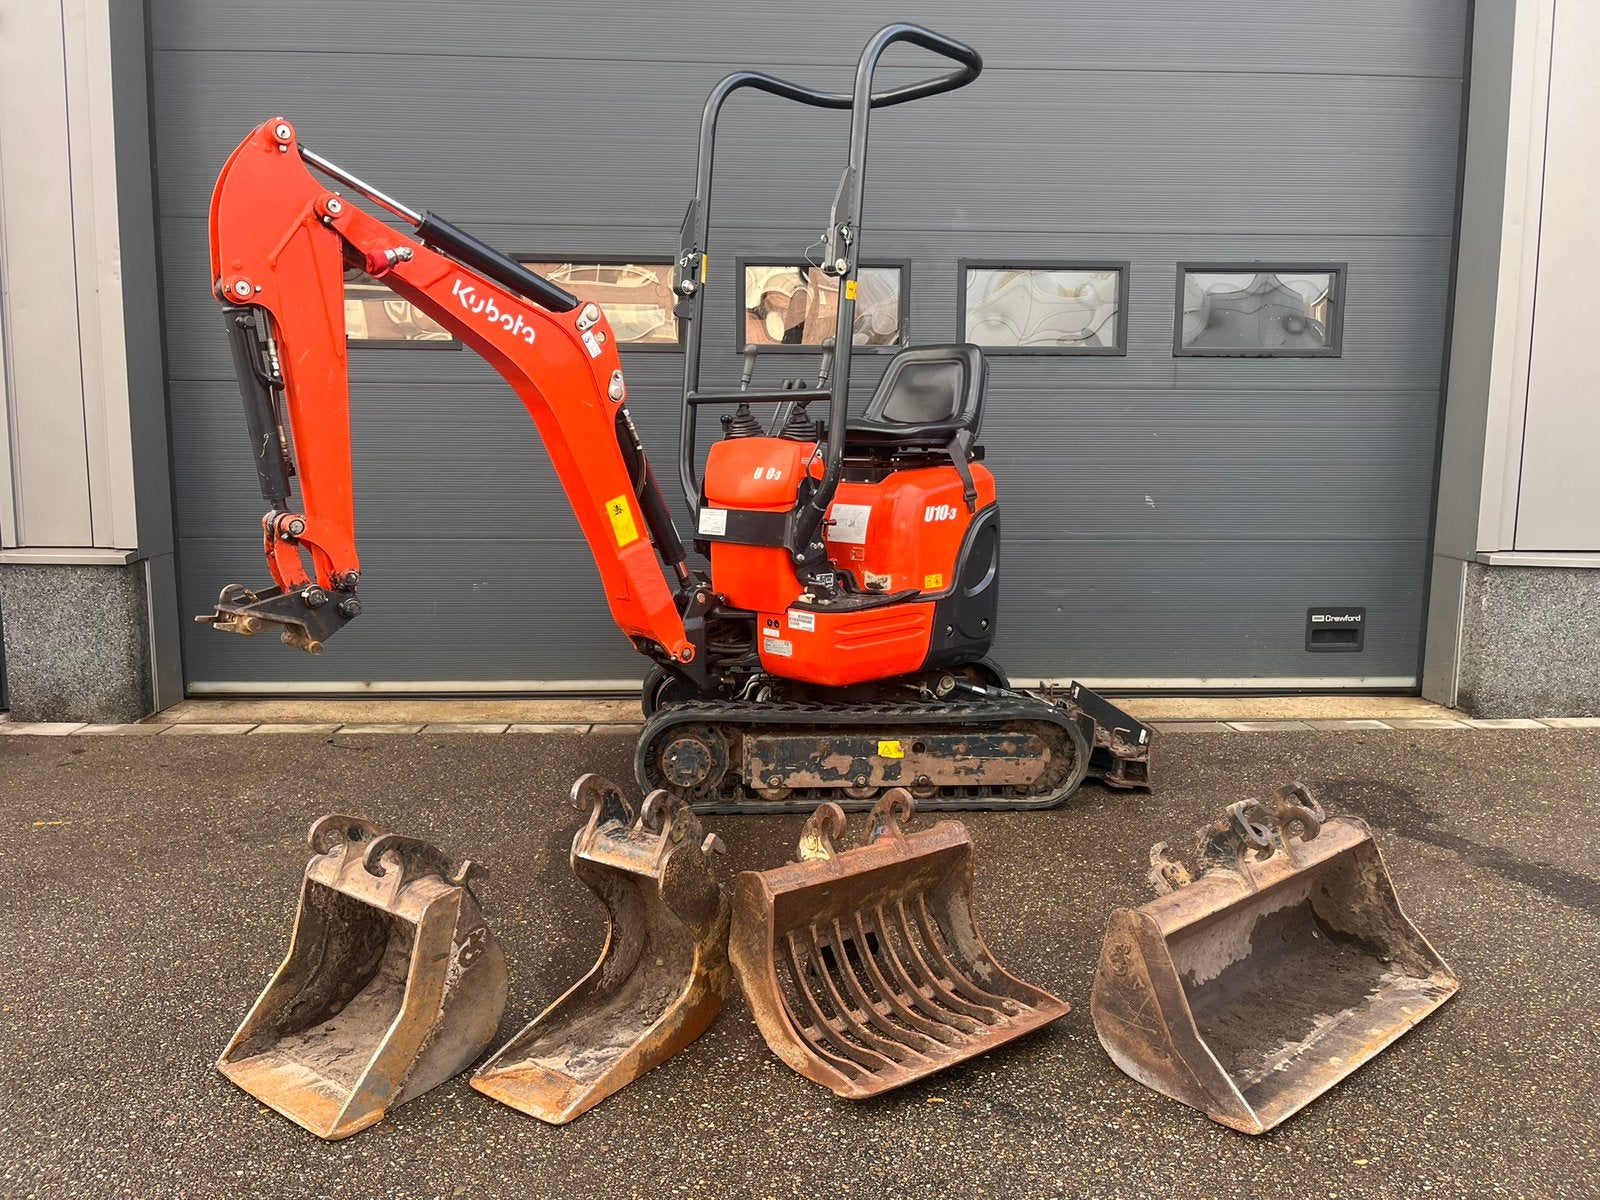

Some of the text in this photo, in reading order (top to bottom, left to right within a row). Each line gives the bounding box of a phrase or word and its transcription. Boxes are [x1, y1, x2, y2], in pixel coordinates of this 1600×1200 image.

[451, 278, 536, 345] Kubota
[924, 503, 958, 523] U10-3
[1325, 614, 1361, 622] Crawford
